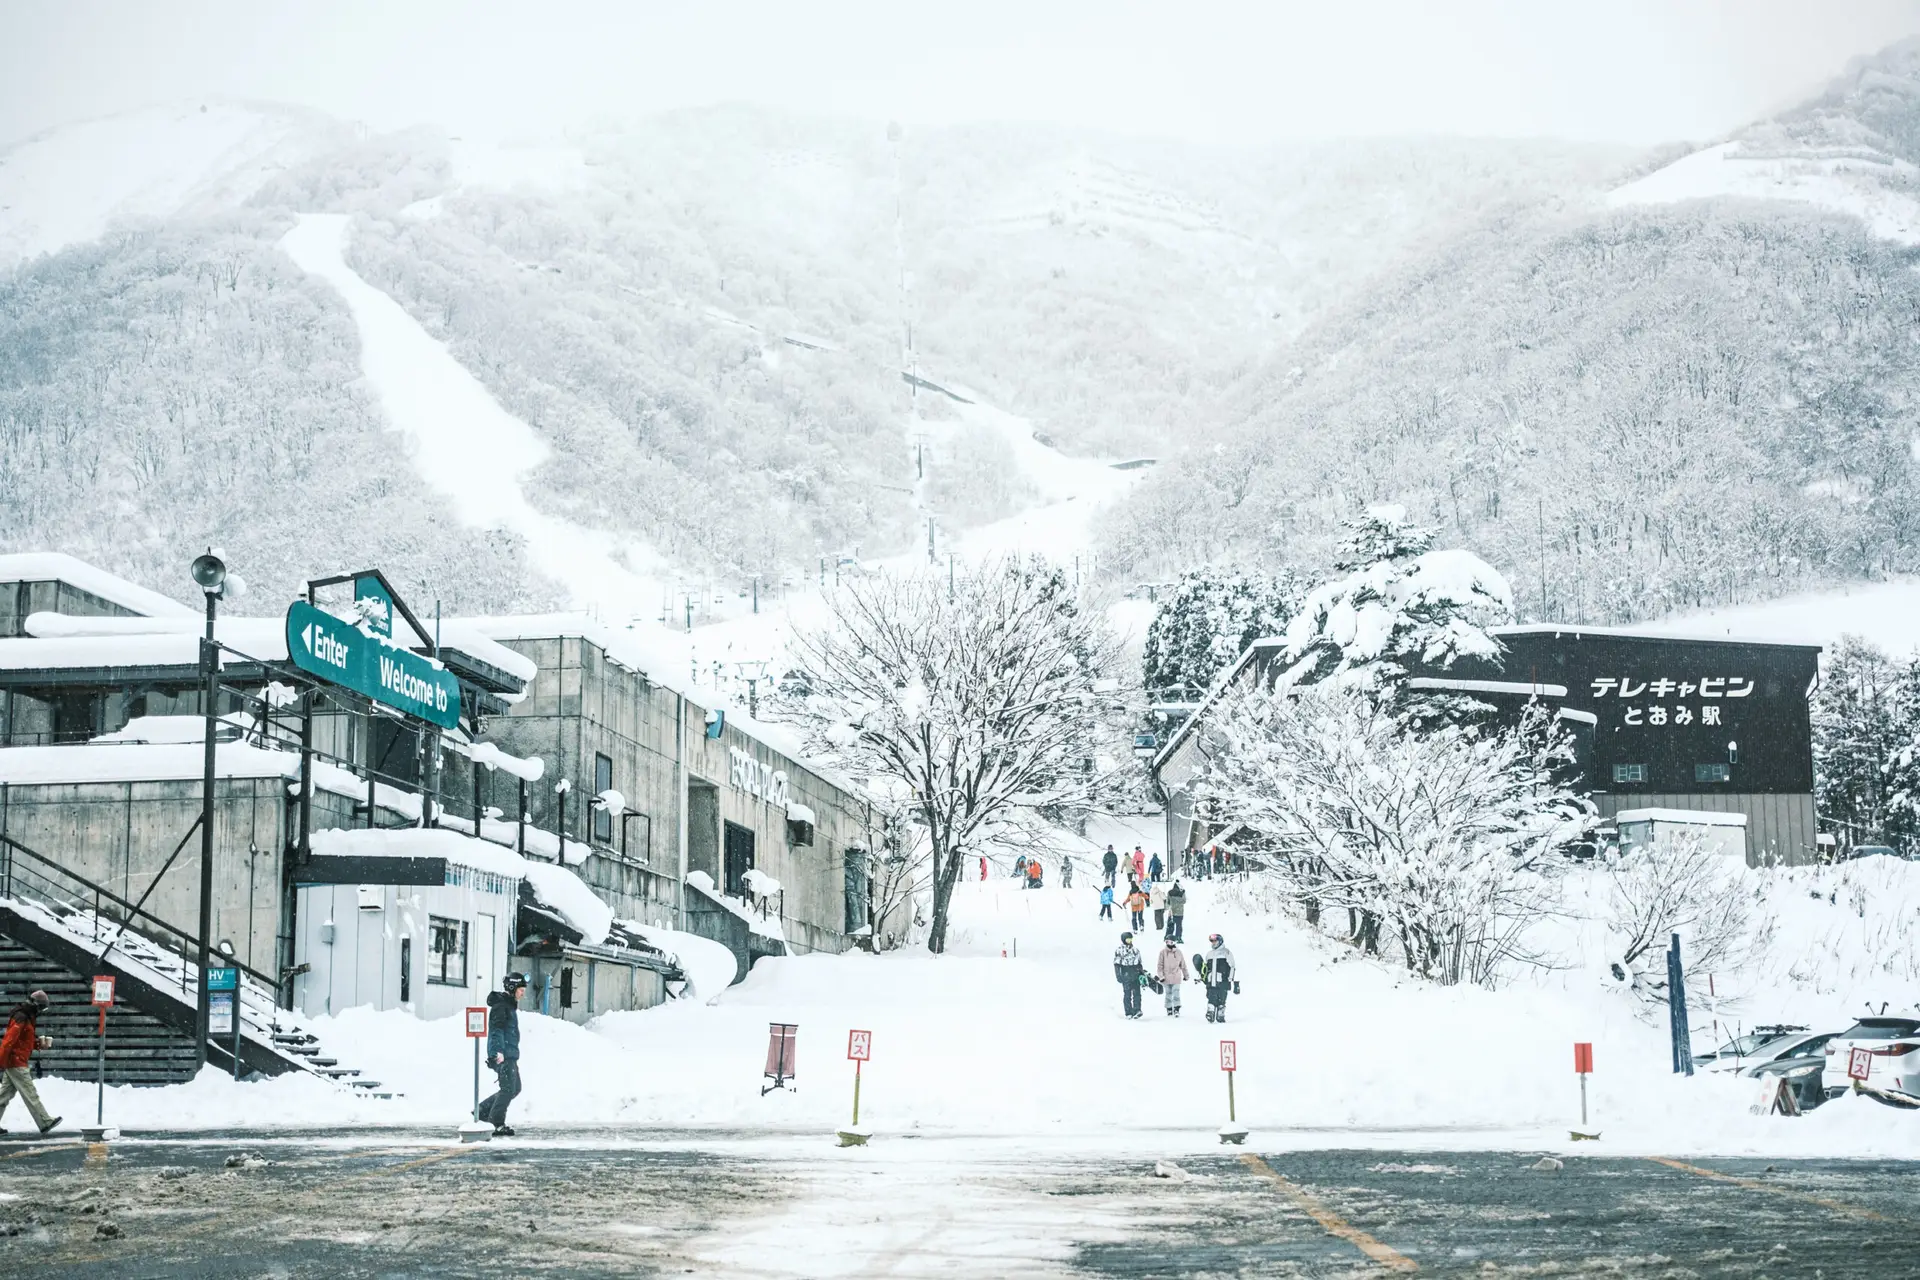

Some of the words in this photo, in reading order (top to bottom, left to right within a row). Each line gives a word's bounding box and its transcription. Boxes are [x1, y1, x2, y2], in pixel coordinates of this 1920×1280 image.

[314, 625, 348, 669] Enter
[380, 655, 433, 707] Welcome
[436, 682, 448, 713] to
[1591, 677, 1754, 698] テレキャビン
[1624, 705, 1722, 726] とおみ駅
[209, 970, 224, 980] HV
[854, 1033, 866, 1055] バス
[1223, 1044, 1232, 1066] バス
[1854, 1053, 1868, 1075] バス
